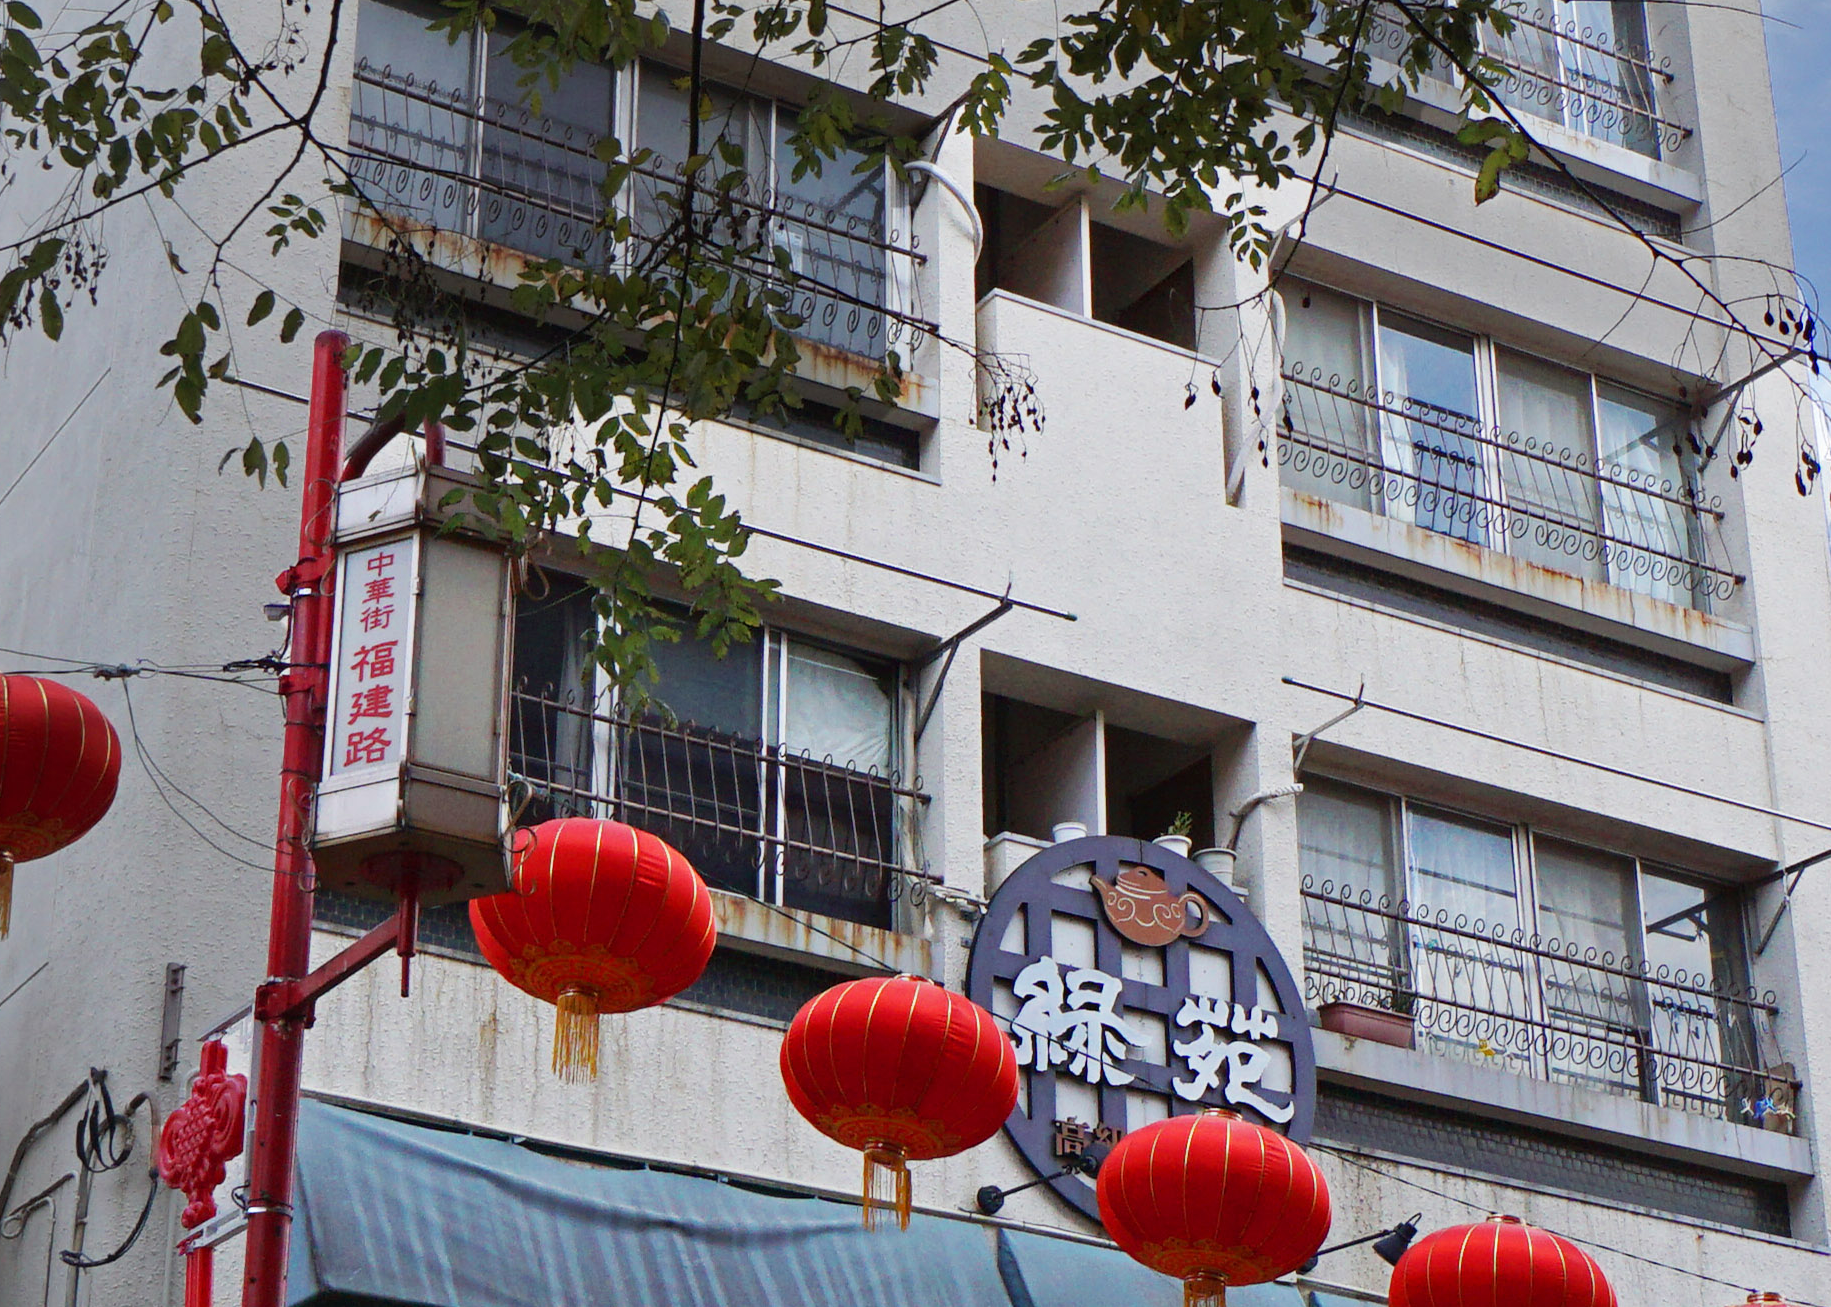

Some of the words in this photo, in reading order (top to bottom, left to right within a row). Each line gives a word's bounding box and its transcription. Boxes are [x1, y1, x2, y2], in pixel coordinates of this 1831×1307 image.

[360, 551, 395, 633] 中華街
[343, 639, 399, 768] 福建路
